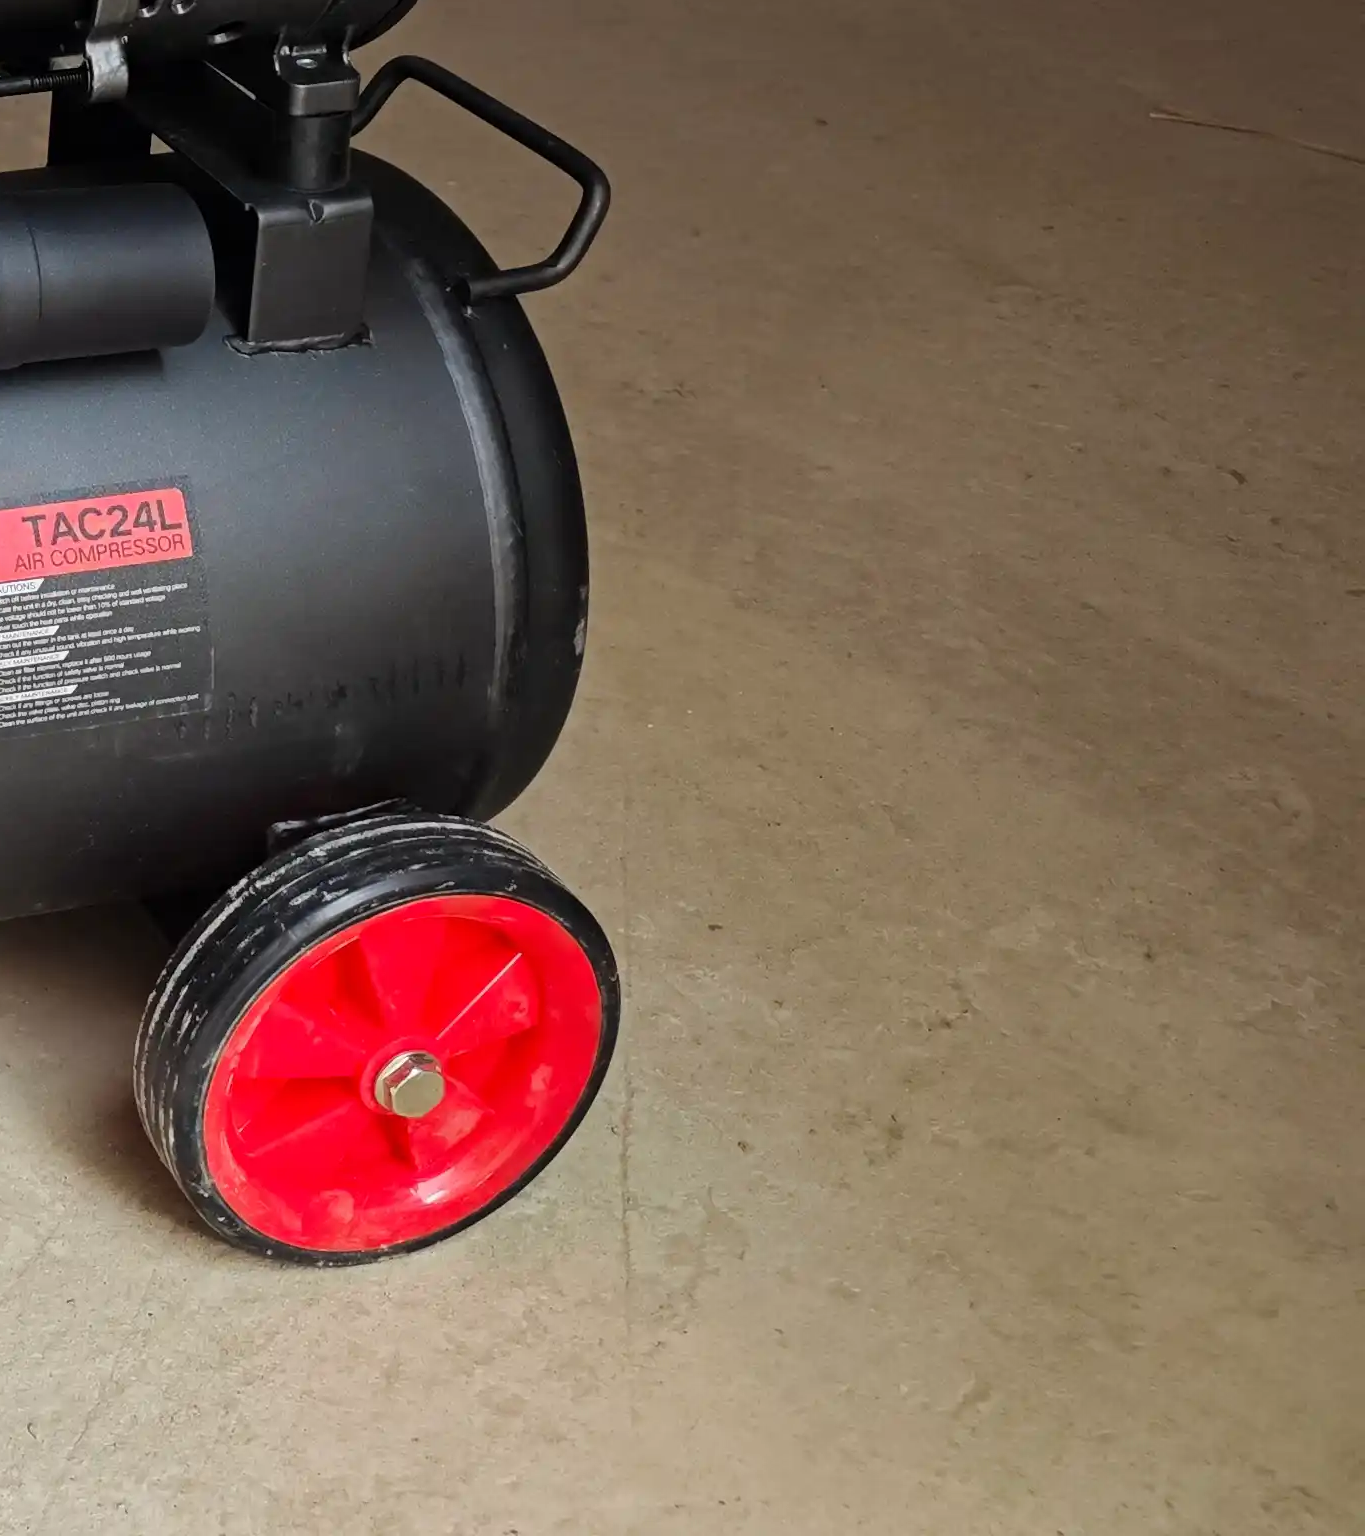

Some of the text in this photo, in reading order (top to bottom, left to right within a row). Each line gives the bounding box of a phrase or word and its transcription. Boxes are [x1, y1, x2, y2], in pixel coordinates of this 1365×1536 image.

[21, 499, 183, 548] TAC24L
[14, 533, 186, 573] AIR COMPRESSOR
